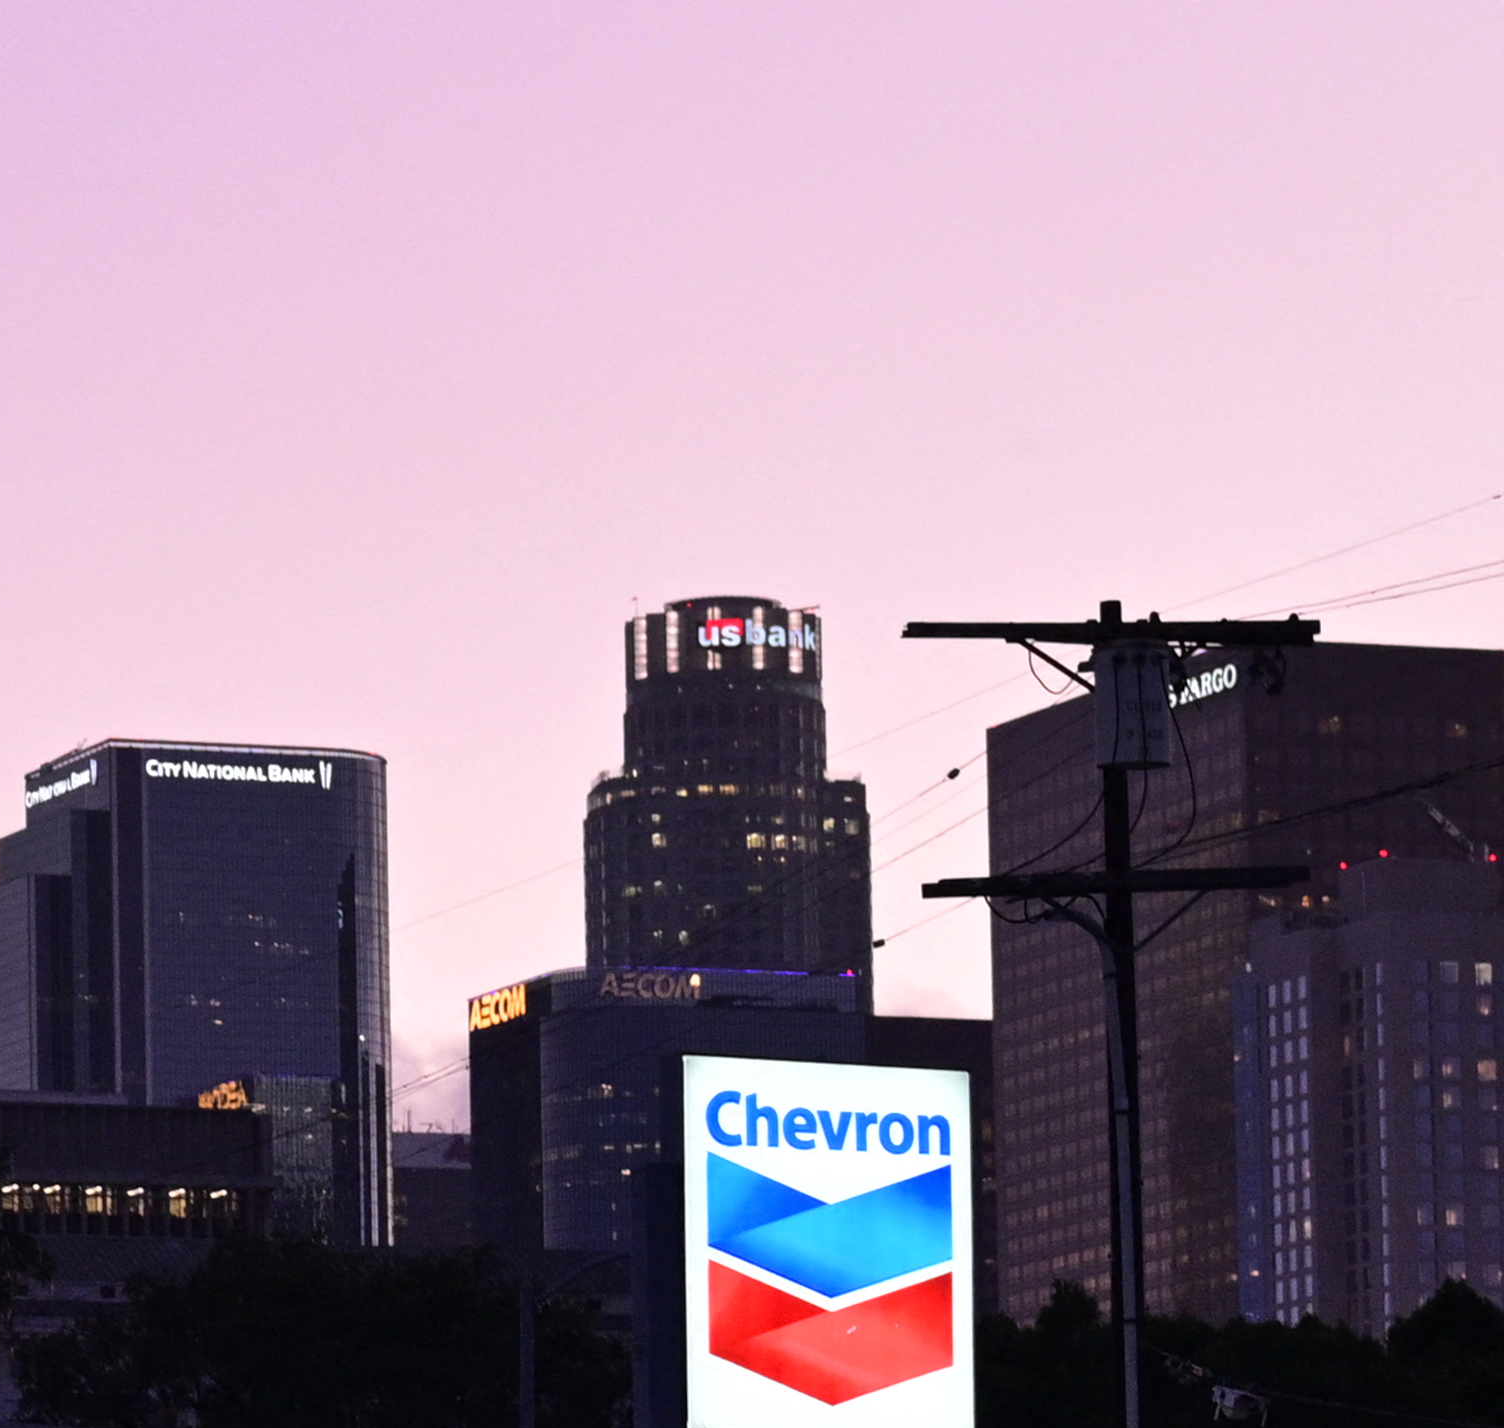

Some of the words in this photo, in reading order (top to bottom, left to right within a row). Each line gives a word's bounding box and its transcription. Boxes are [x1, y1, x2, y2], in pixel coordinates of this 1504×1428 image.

[146, 759, 181, 778] CITY
[182, 761, 267, 782] NATIONAL
[267, 765, 315, 783] BANK
[601, 973, 701, 999] AECOM
[469, 983, 527, 1032] AECOM
[705, 1090, 951, 1156] Chevron
